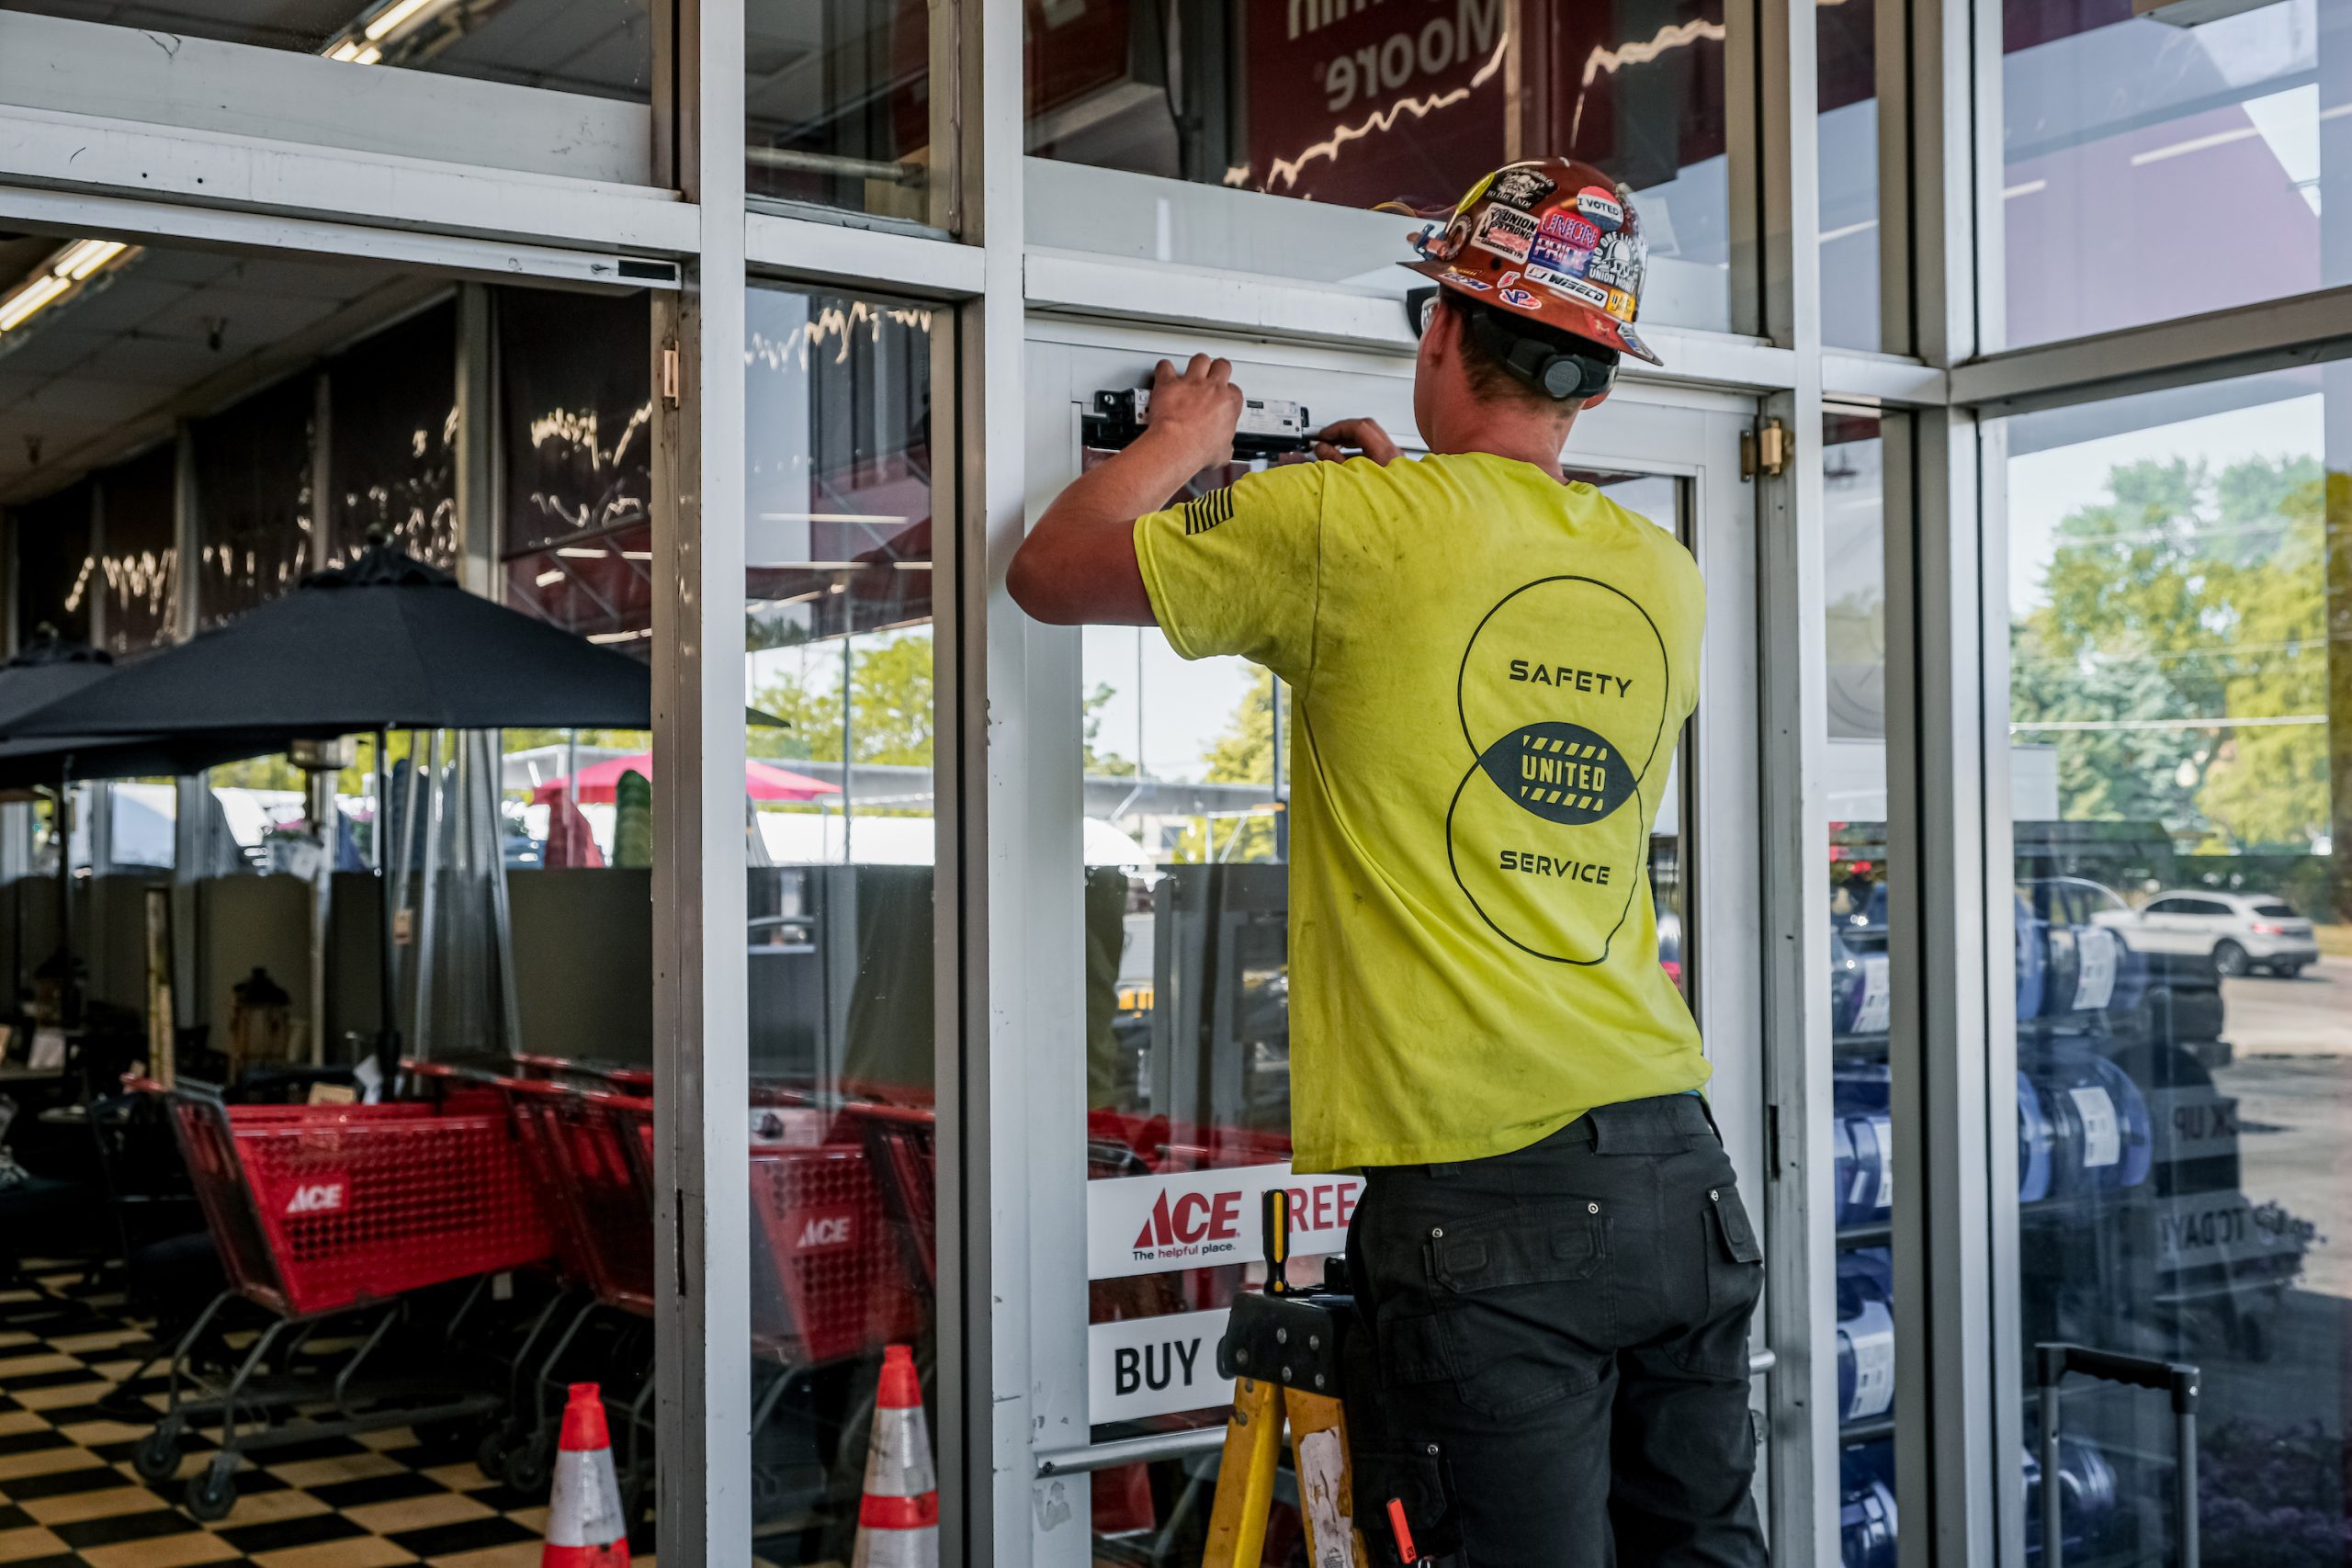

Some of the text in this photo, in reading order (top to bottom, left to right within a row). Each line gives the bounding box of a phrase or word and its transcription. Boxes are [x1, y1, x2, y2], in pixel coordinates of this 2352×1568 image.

[1577, 197, 1584, 206] I
[1498, 221, 1532, 239] STRONG
[1503, 209, 1539, 232] UNION
[1541, 212, 1598, 249] UNION
[1532, 233, 1590, 273] PRIDE
[1591, 247, 1604, 265] NO
[1599, 231, 1618, 248] ONE
[1589, 267, 1616, 286] UNION
[1503, 288, 1530, 304] VP
[1509, 659, 1634, 698] SAFETY
[1521, 753, 1607, 793] UNITED
[1499, 850, 1611, 886] SERVICE
[286, 1182, 344, 1213] ACE
[1261, 1182, 1357, 1233] REE
[797, 1217, 851, 1249] ACE
[1133, 1186, 1243, 1249] ACE
[1133, 1243, 1237, 1261] The helpful place.
[1114, 1337, 1202, 1396] BUY
